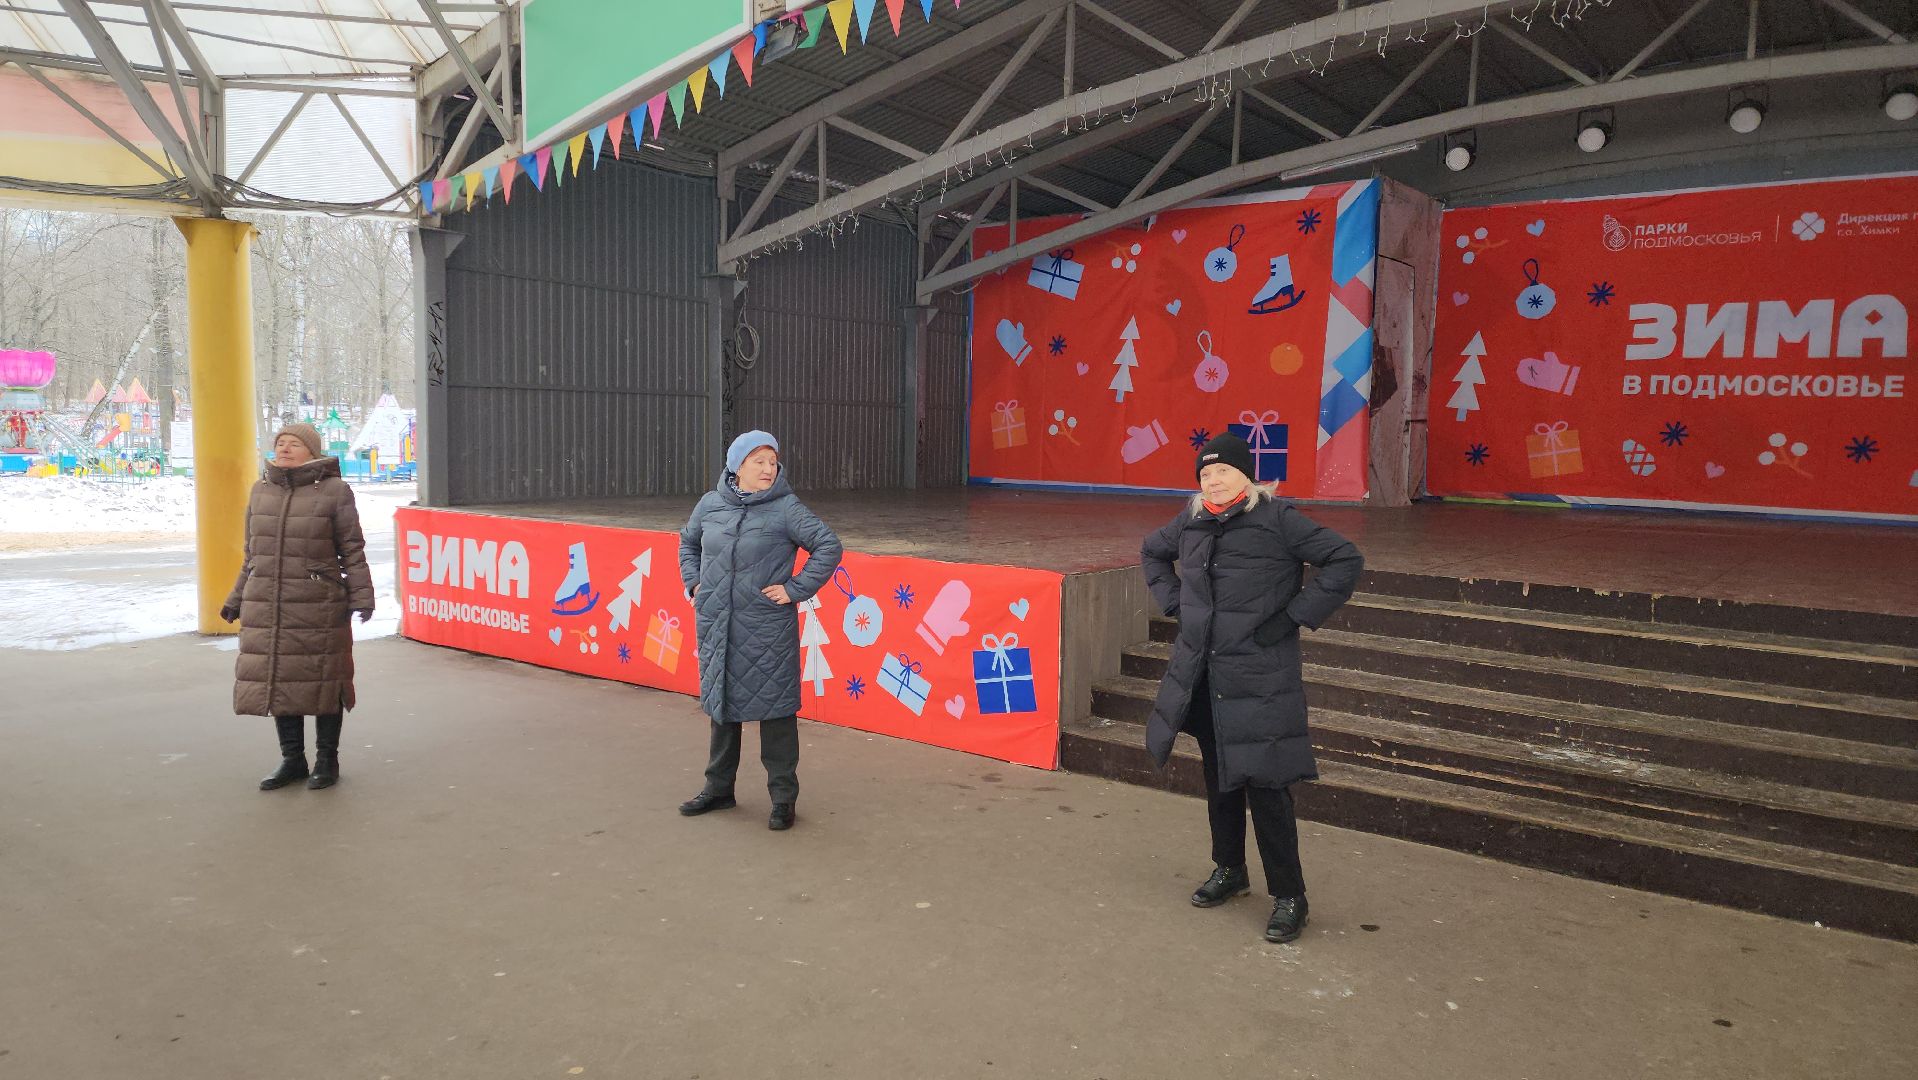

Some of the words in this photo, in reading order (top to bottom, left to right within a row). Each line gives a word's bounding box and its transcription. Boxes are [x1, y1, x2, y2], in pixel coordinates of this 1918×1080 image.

[1635, 222, 1688, 236] ПАРКИ
[1837, 212, 1909, 225] Дирекция
[1633, 231, 1762, 249] ПОДМОСКОВЬЯ
[1861, 224, 1900, 236] Химки
[1625, 294, 1909, 361] ЗИМА
[1649, 374, 1905, 400] ПОДМОСКОВЬЕ
[406, 530, 530, 599] ЗИМА
[418, 597, 530, 634] ПОДМОСКОВЬЕ
